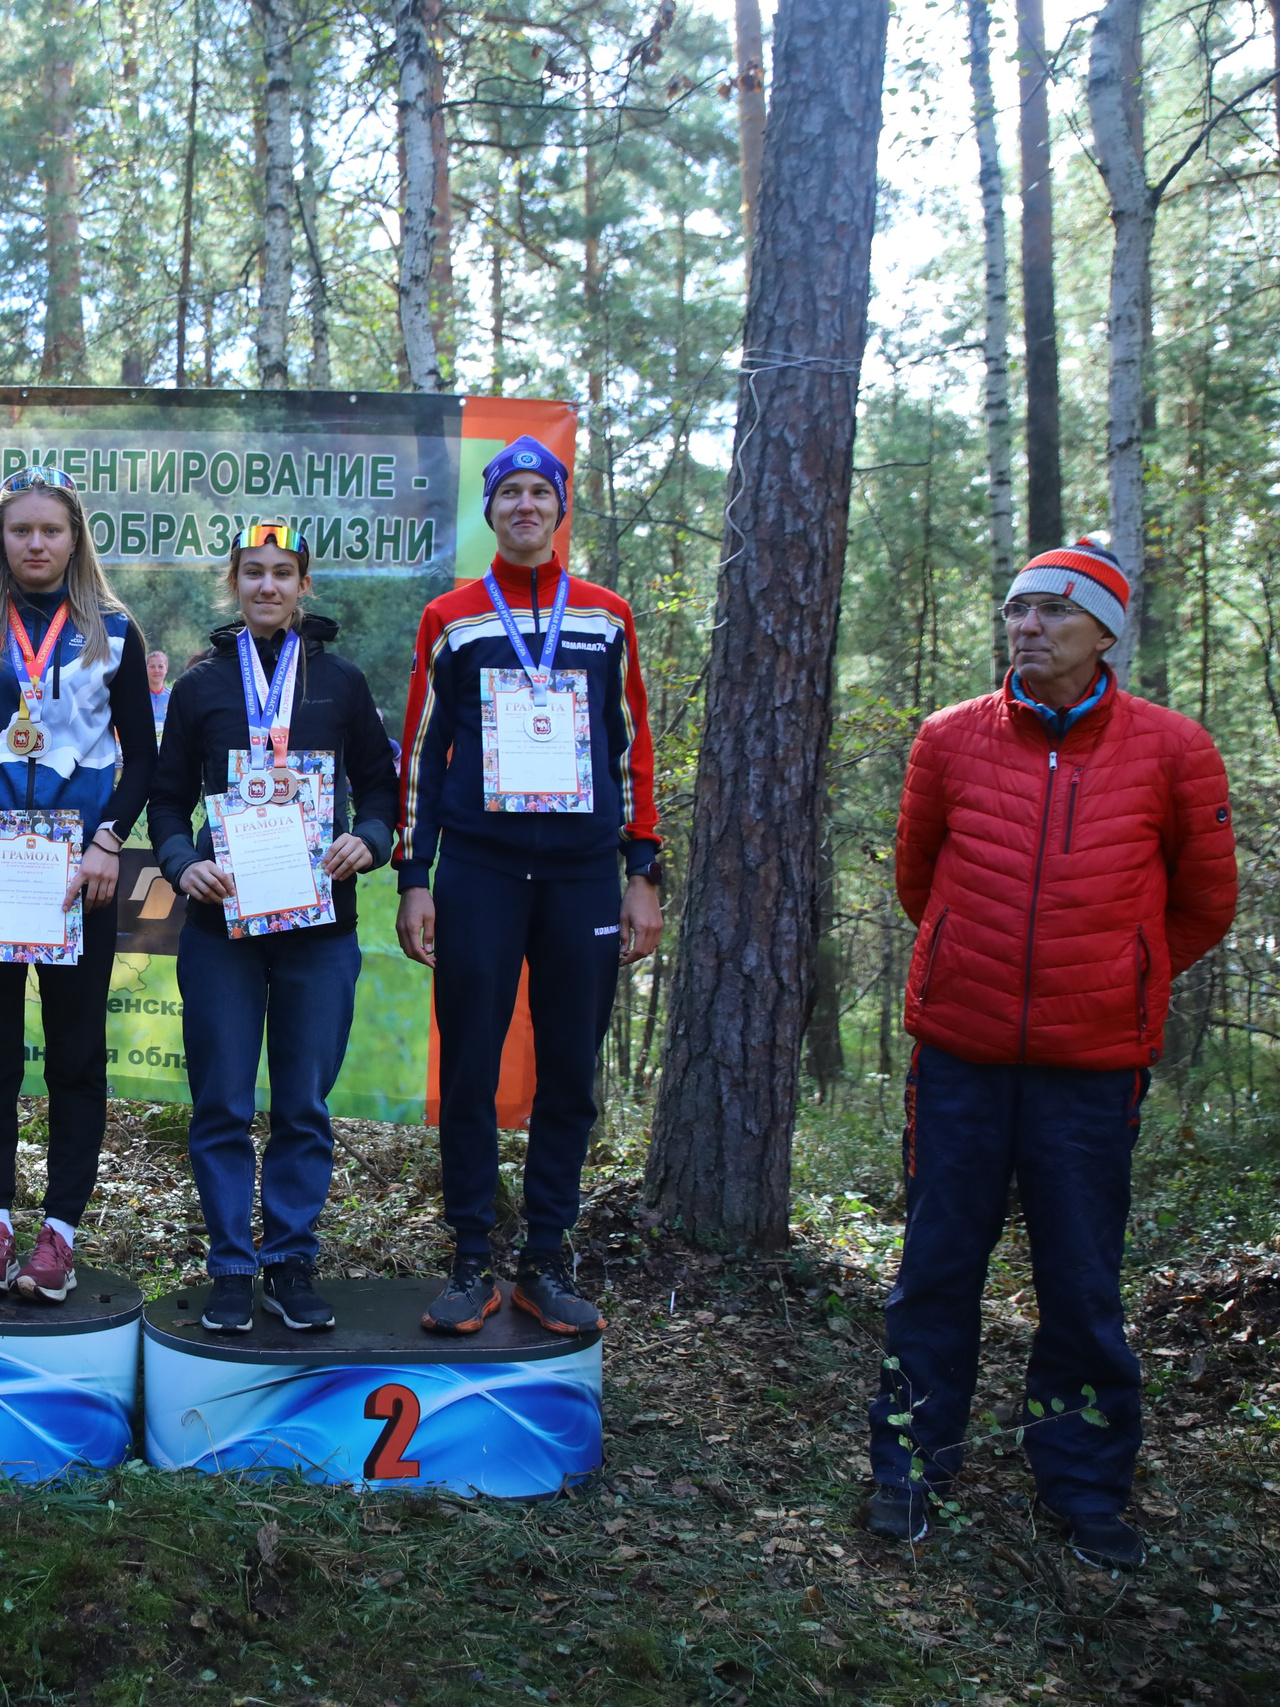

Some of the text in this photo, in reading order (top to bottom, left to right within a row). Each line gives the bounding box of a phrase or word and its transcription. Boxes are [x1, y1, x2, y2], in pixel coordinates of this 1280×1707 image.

[489, 583, 527, 656] ЧЕЛЯБИНСКАЯ ОБЛАСТЬ
[38, 636, 53, 664] ОБЛАСТЬ
[545, 623, 558, 654] ОБЛАСТЬ
[561, 640, 606, 653] КОМАНДА74
[240, 638, 256, 715] ЧЕЛЯБИНСКАЯ ОБЛАСТЬ
[266, 685, 280, 716] ОБЛАСТЬ
[505, 702, 565, 712] ГРАМТА
[233, 816, 295, 834] ГРАМОТА
[1, 850, 60, 862] ГРАМОТА
[127, 1046, 188, 1070] обла
[363, 1382, 421, 1480] 2
